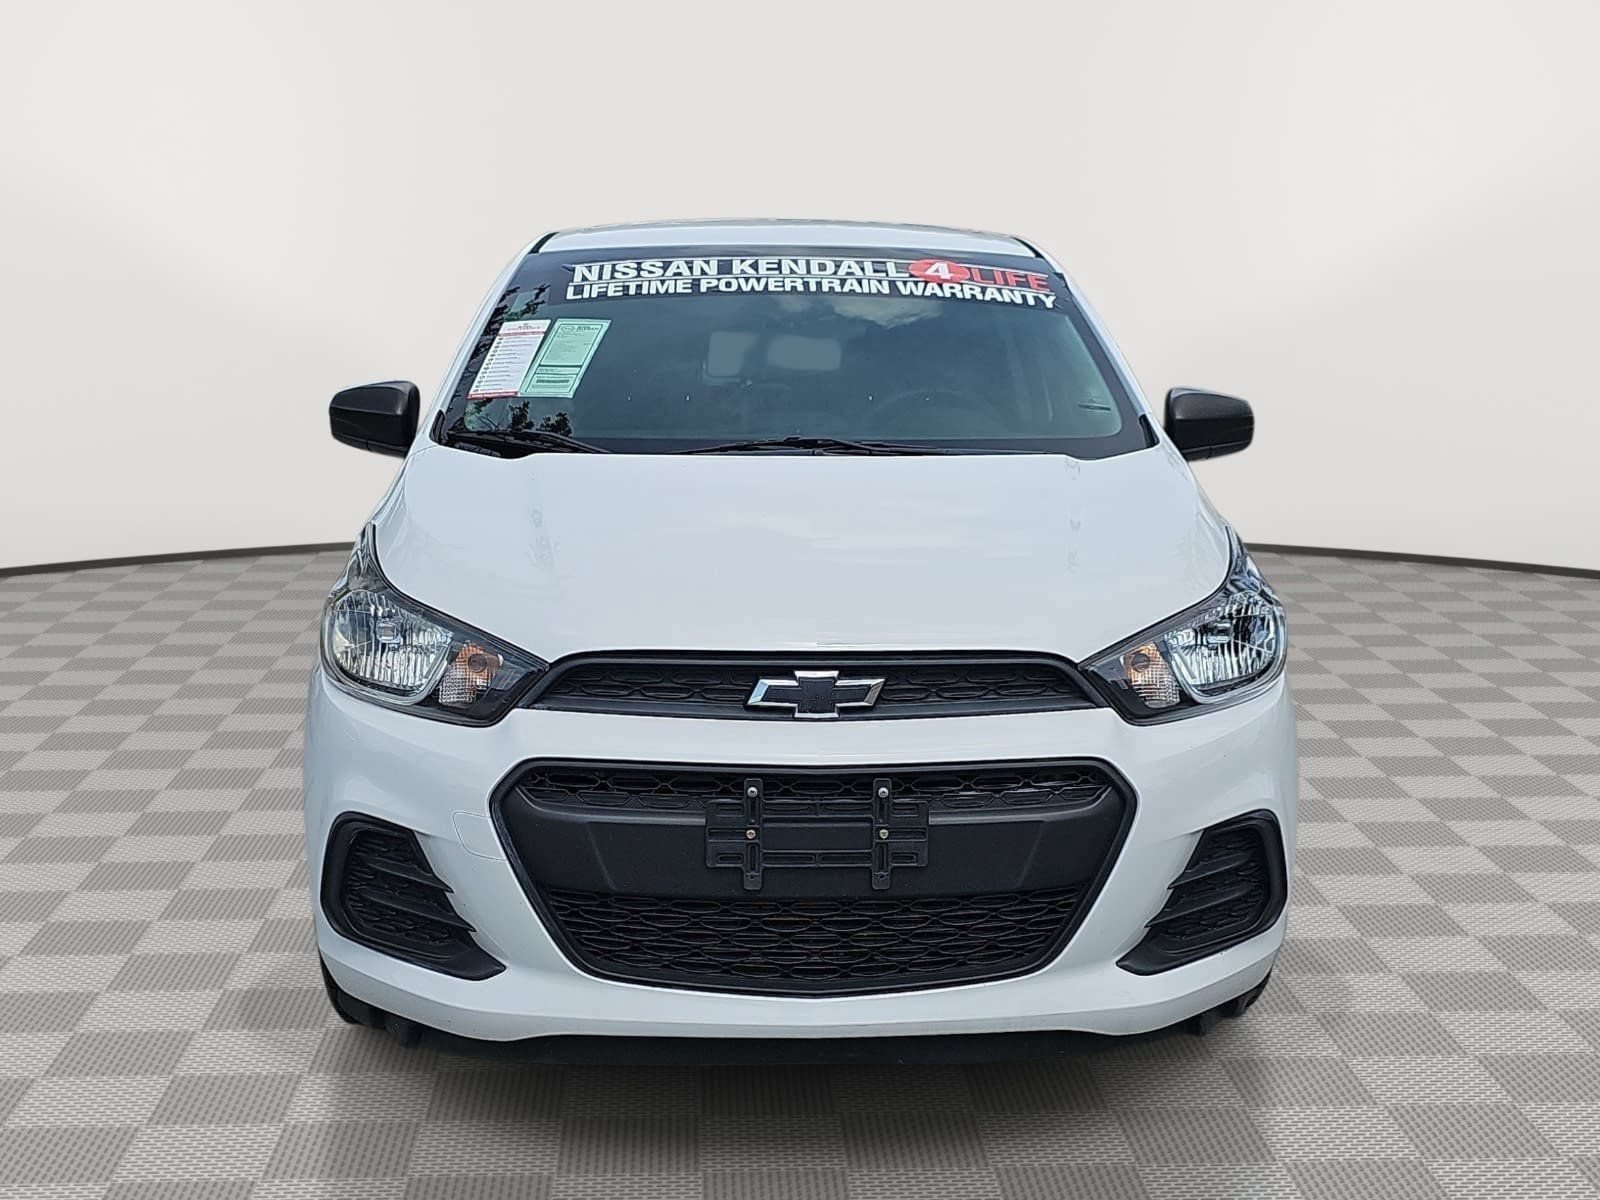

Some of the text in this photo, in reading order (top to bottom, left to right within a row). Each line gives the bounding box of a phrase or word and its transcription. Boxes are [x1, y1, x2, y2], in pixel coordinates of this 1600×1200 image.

[573, 259, 1051, 292] NISSAN KENDALL 4 LIFE
[566, 278, 1057, 309] LIFETIME POWERTRAIN WARRANTY
